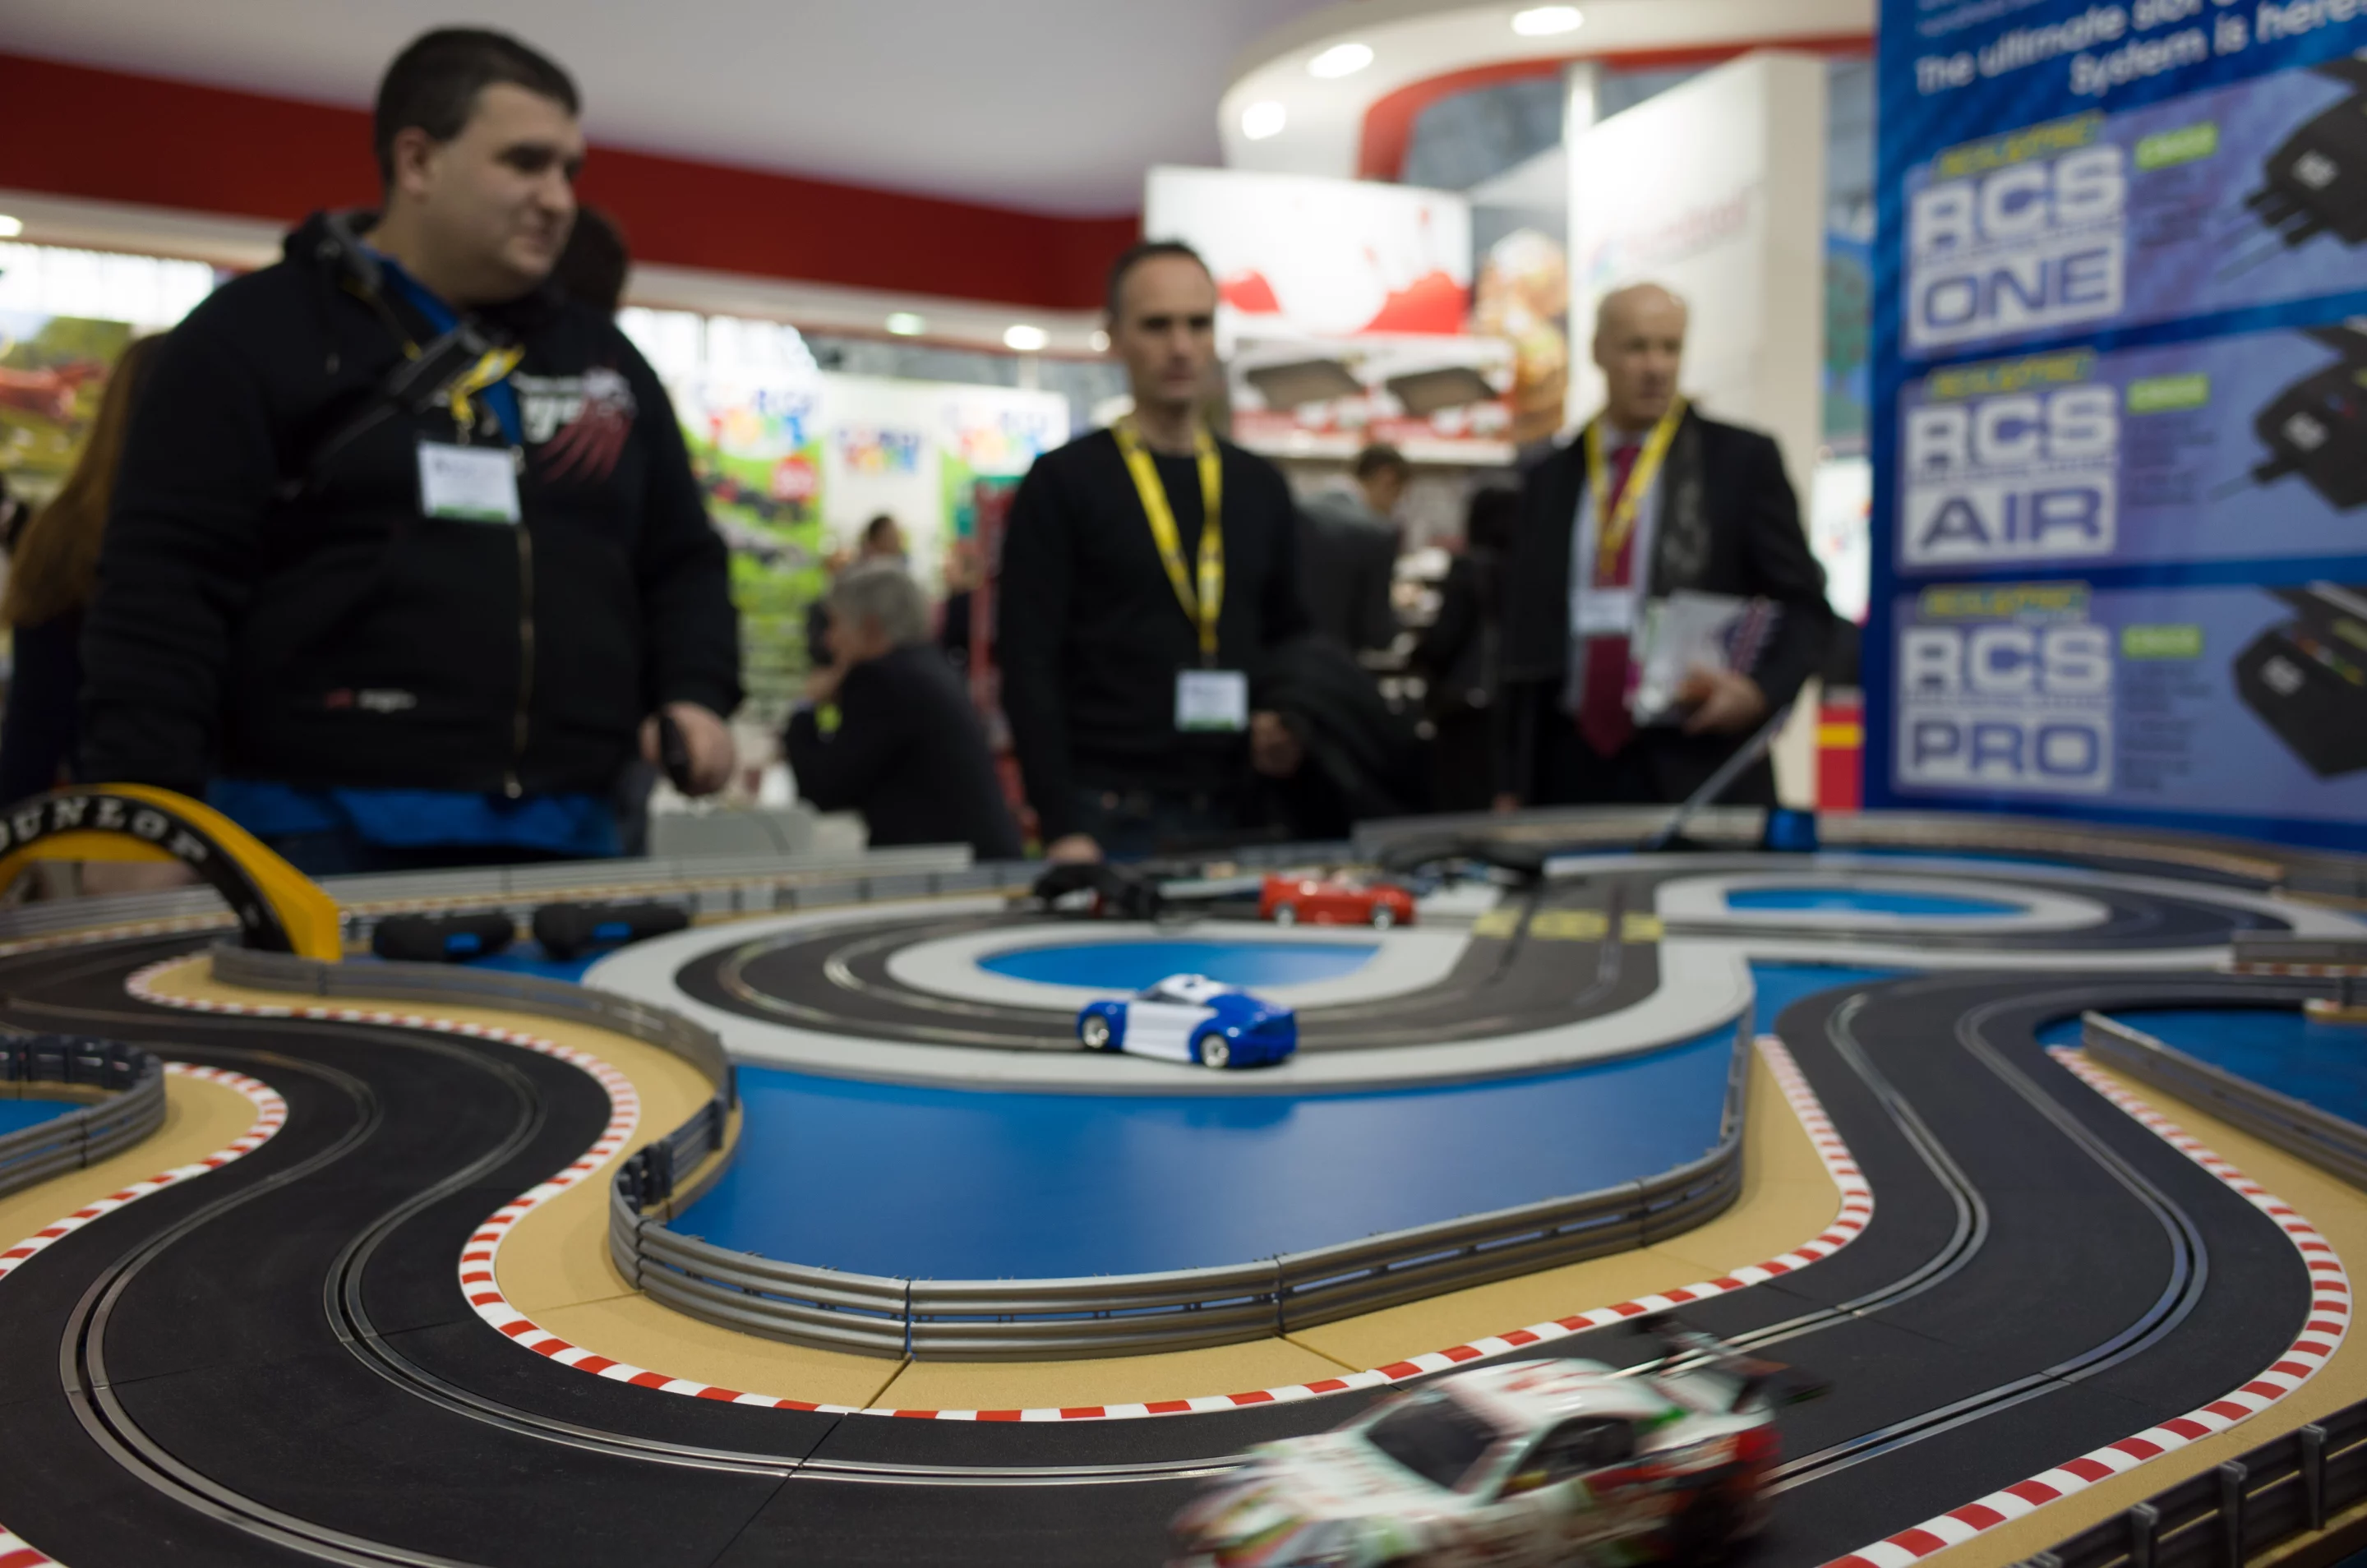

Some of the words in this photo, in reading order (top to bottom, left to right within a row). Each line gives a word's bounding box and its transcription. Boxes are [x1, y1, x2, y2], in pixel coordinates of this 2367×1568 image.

[1916, 55, 1974, 95] The
[1978, 6, 2128, 77] ultimate
[2069, 27, 2208, 98] System
[2213, 12, 2249, 56] is
[1911, 145, 2126, 255] RCS
[1922, 247, 2110, 330] ONE
[1905, 385, 2119, 472] RCS
[1921, 487, 2102, 548] AIR
[1899, 625, 2112, 694] RCS
[1913, 719, 2100, 776] PRO
